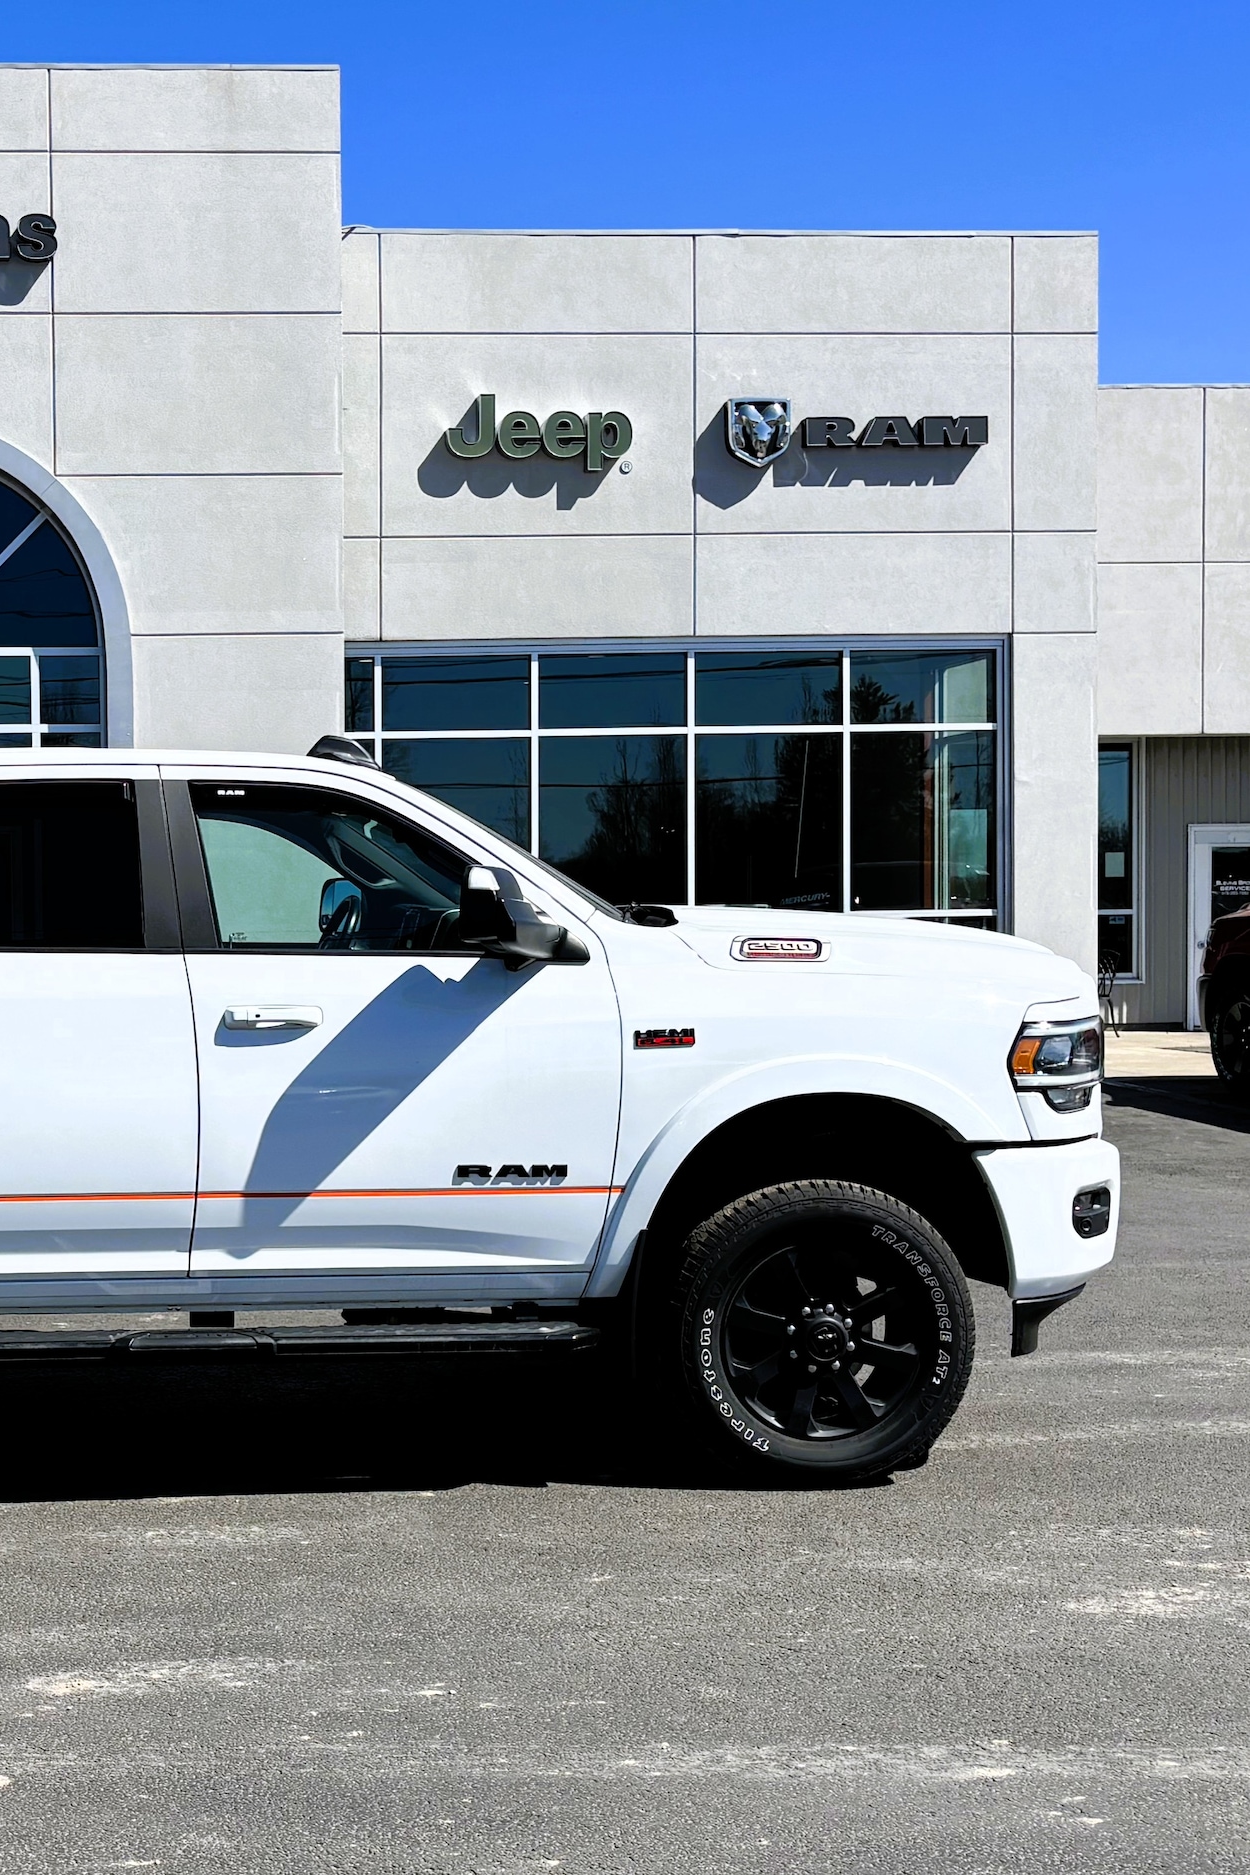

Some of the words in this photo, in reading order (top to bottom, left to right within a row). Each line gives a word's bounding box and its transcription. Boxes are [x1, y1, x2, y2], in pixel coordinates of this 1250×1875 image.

[447, 394, 633, 473] Jeep
[804, 415, 989, 447] RAM
[634, 1028, 695, 1038] HEMI
[456, 1164, 568, 1178] RAM
[872, 1224, 953, 1342] TRANSFORCE
